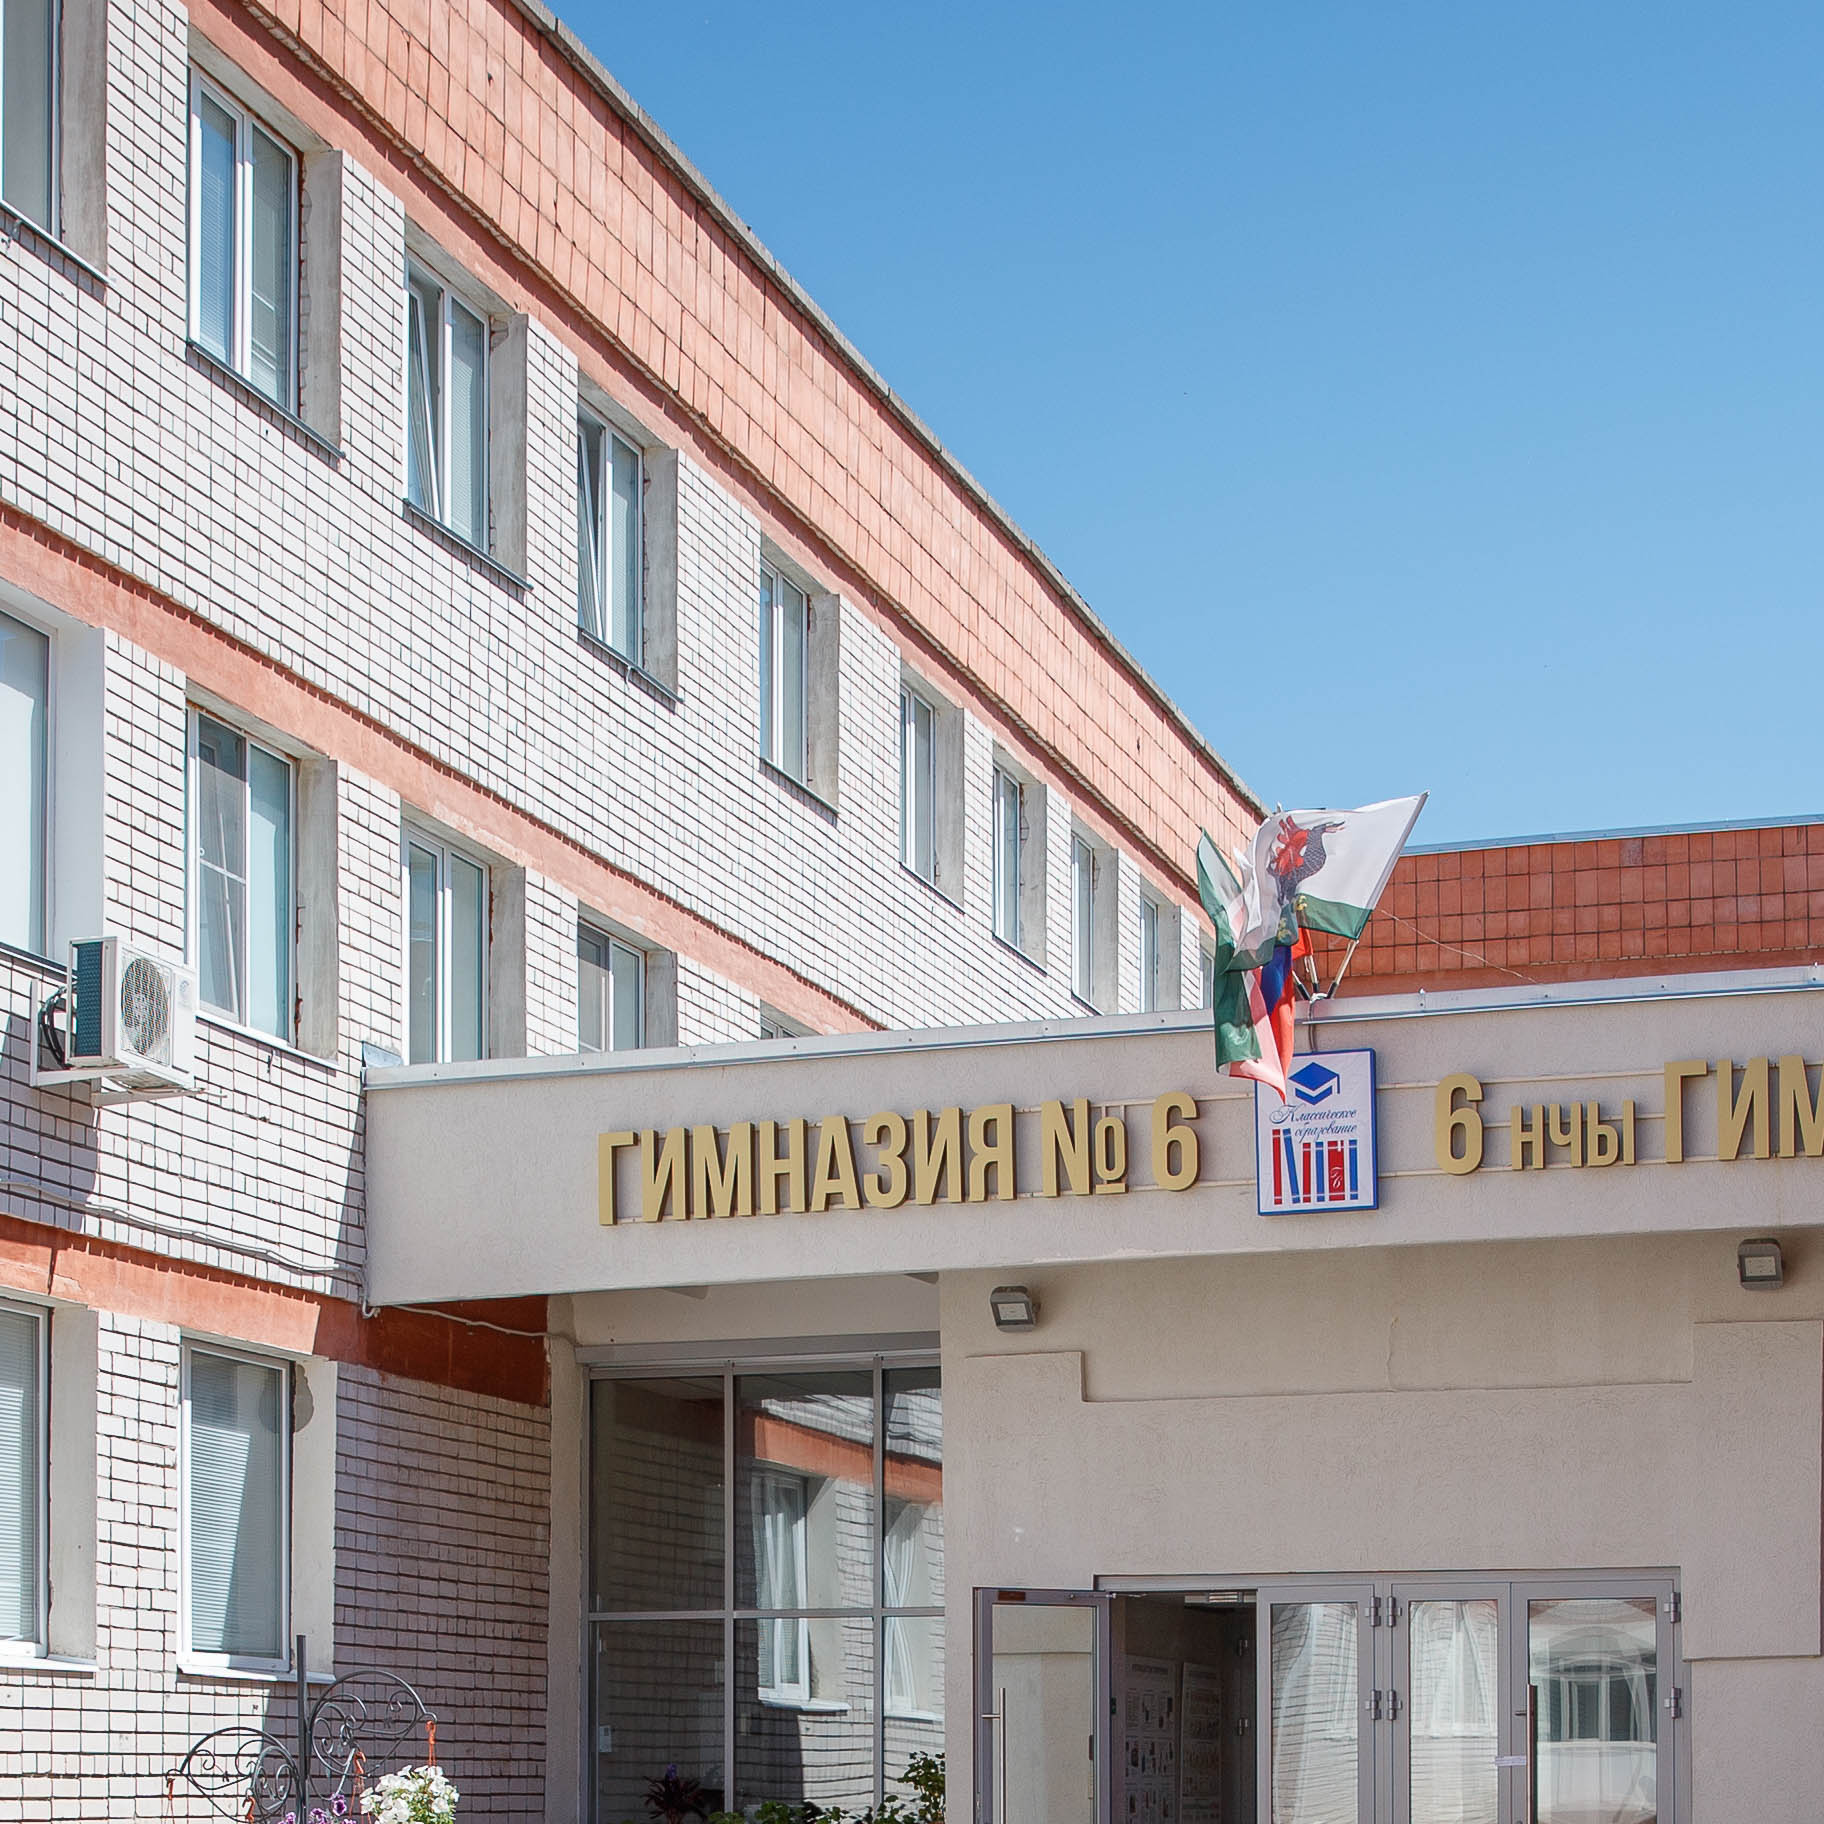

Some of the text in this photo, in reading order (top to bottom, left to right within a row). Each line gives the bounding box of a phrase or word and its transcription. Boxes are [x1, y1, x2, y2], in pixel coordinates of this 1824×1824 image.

[1269, 1103, 1357, 1125] Классическое
[1295, 1120, 1358, 1143] образование
[1435, 1072, 1484, 1176] 6
[598, 1091, 1200, 1226] ГИМНАЗИЯ № 6
